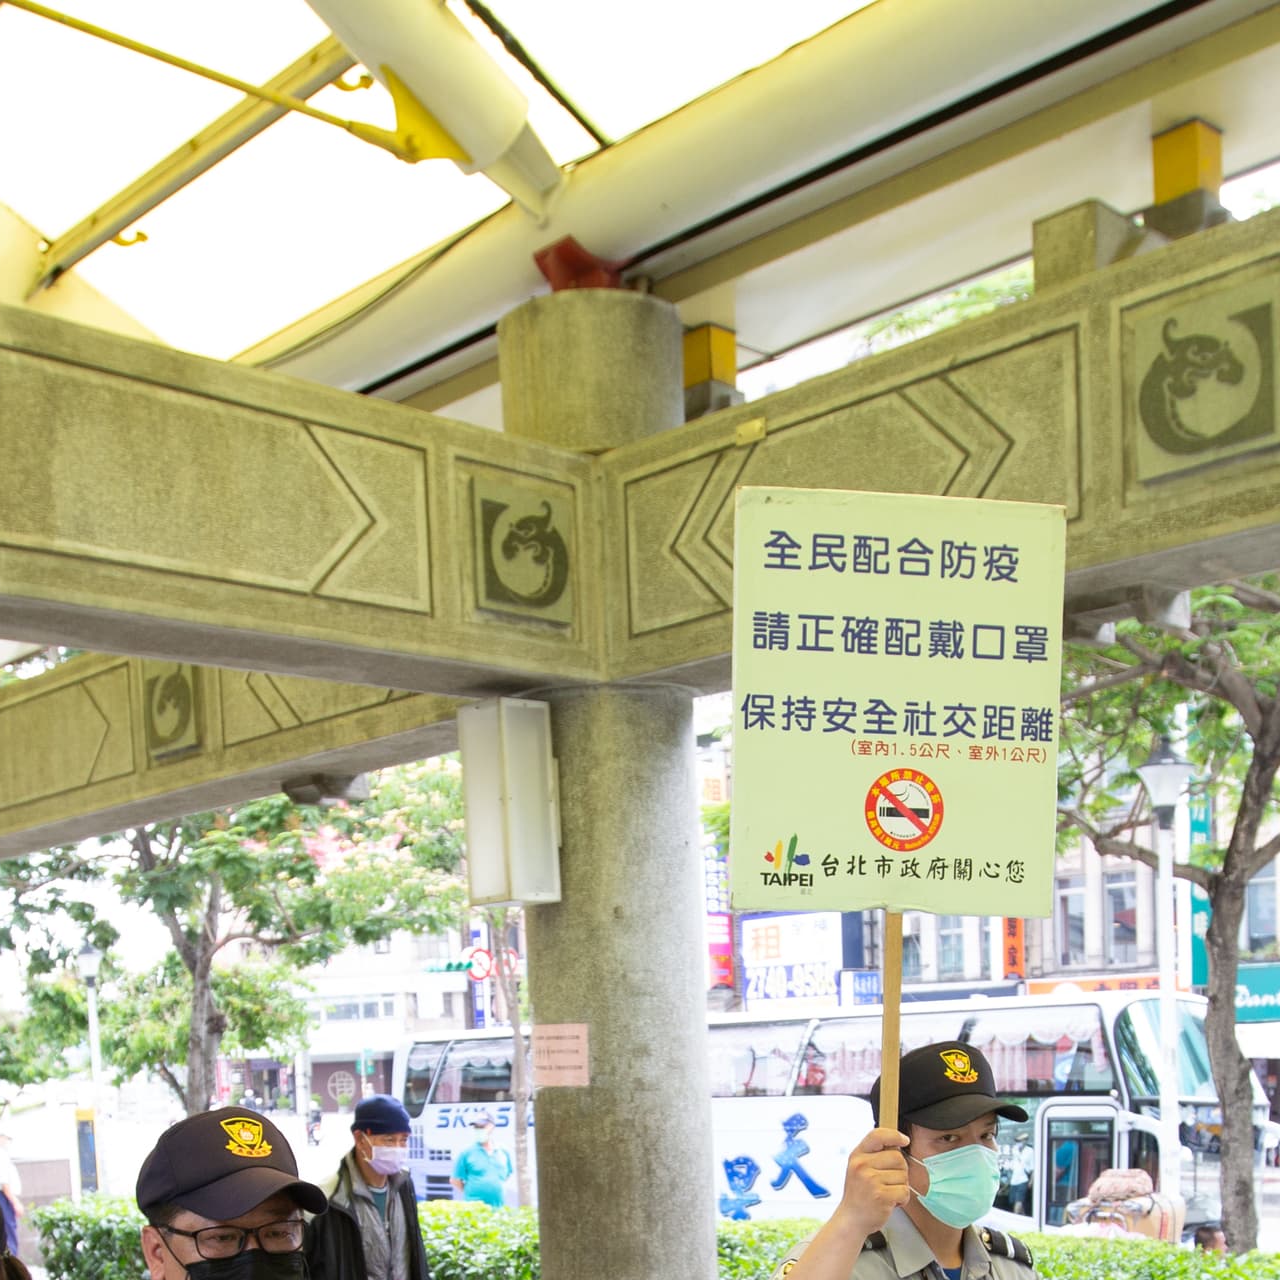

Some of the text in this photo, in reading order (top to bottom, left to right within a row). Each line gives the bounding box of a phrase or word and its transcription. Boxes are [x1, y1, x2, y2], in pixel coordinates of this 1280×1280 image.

[763, 530, 1020, 583] 全民配合防疫
[751, 610, 1049, 663] 請正確配戴口罩
[740, 693, 1054, 743] 保持安全社交距離
[760, 872, 813, 887] TAIPEI
[821, 853, 1025, 884] 台北市政府關心您
[436, 1107, 486, 1128] SK
